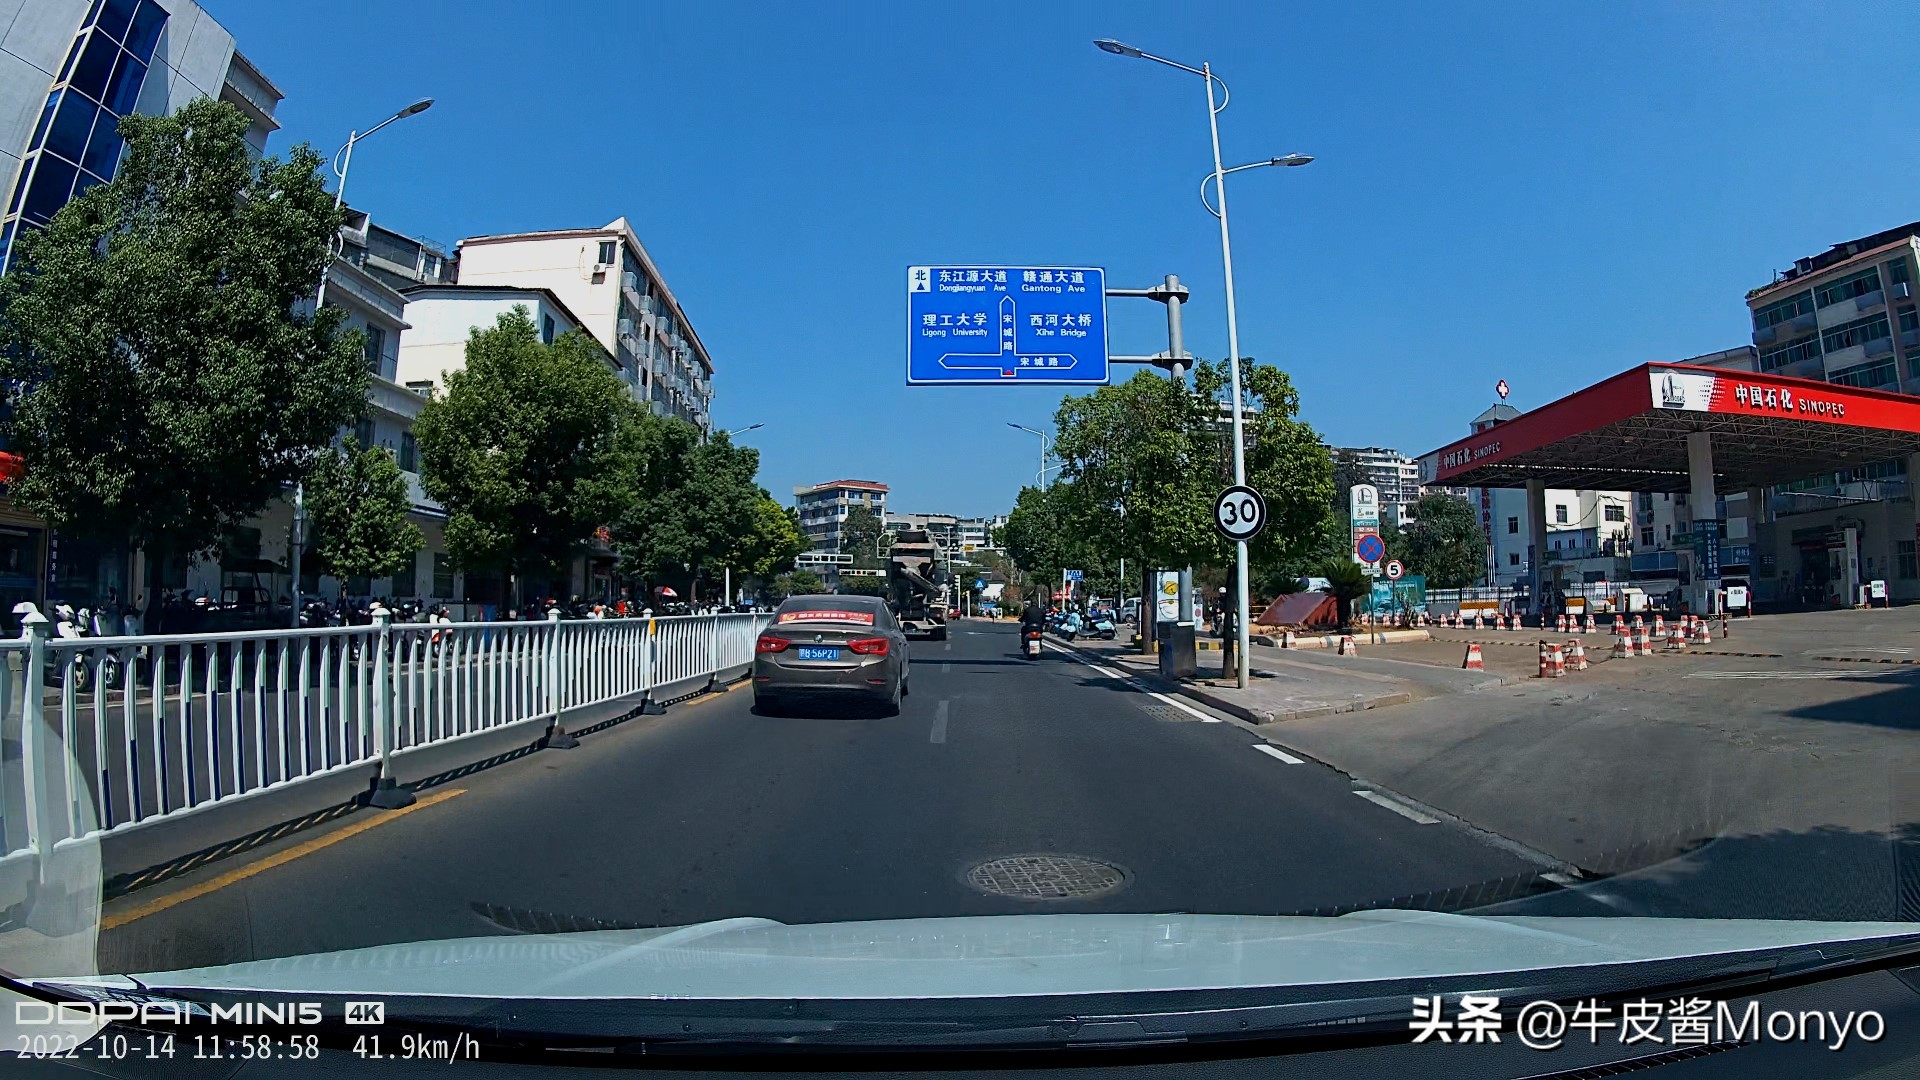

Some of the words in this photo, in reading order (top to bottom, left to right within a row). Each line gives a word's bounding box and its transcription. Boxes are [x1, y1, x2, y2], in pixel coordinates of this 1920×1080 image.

[914, 269, 927, 281] 北
[939, 270, 1008, 283] 东江源大道
[1022, 270, 1085, 284] 赣通大道
[939, 284, 986, 293] Dongjiangyuan
[993, 284, 1007, 292] Ave
[1021, 284, 1062, 294] Gantong
[1067, 284, 1086, 293] Ave
[922, 312, 988, 327] 理工大学
[1029, 313, 1092, 327] 西河大桥
[922, 328, 947, 338] Ligong
[952, 328, 988, 338] University
[1002, 314, 1014, 351] 宋城路
[1035, 328, 1055, 337] Xihe
[1060, 328, 1087, 338] Bridge
[1020, 356, 1059, 367] 宋城路
[1734, 383, 1794, 409] 中国石化
[1799, 398, 1845, 416] SINOPEC
[1443, 447, 1471, 470] 中国石化
[1473, 441, 1501, 460] SINOPEC
[1223, 499, 1256, 526] 30
[1390, 564, 1399, 576] 5
